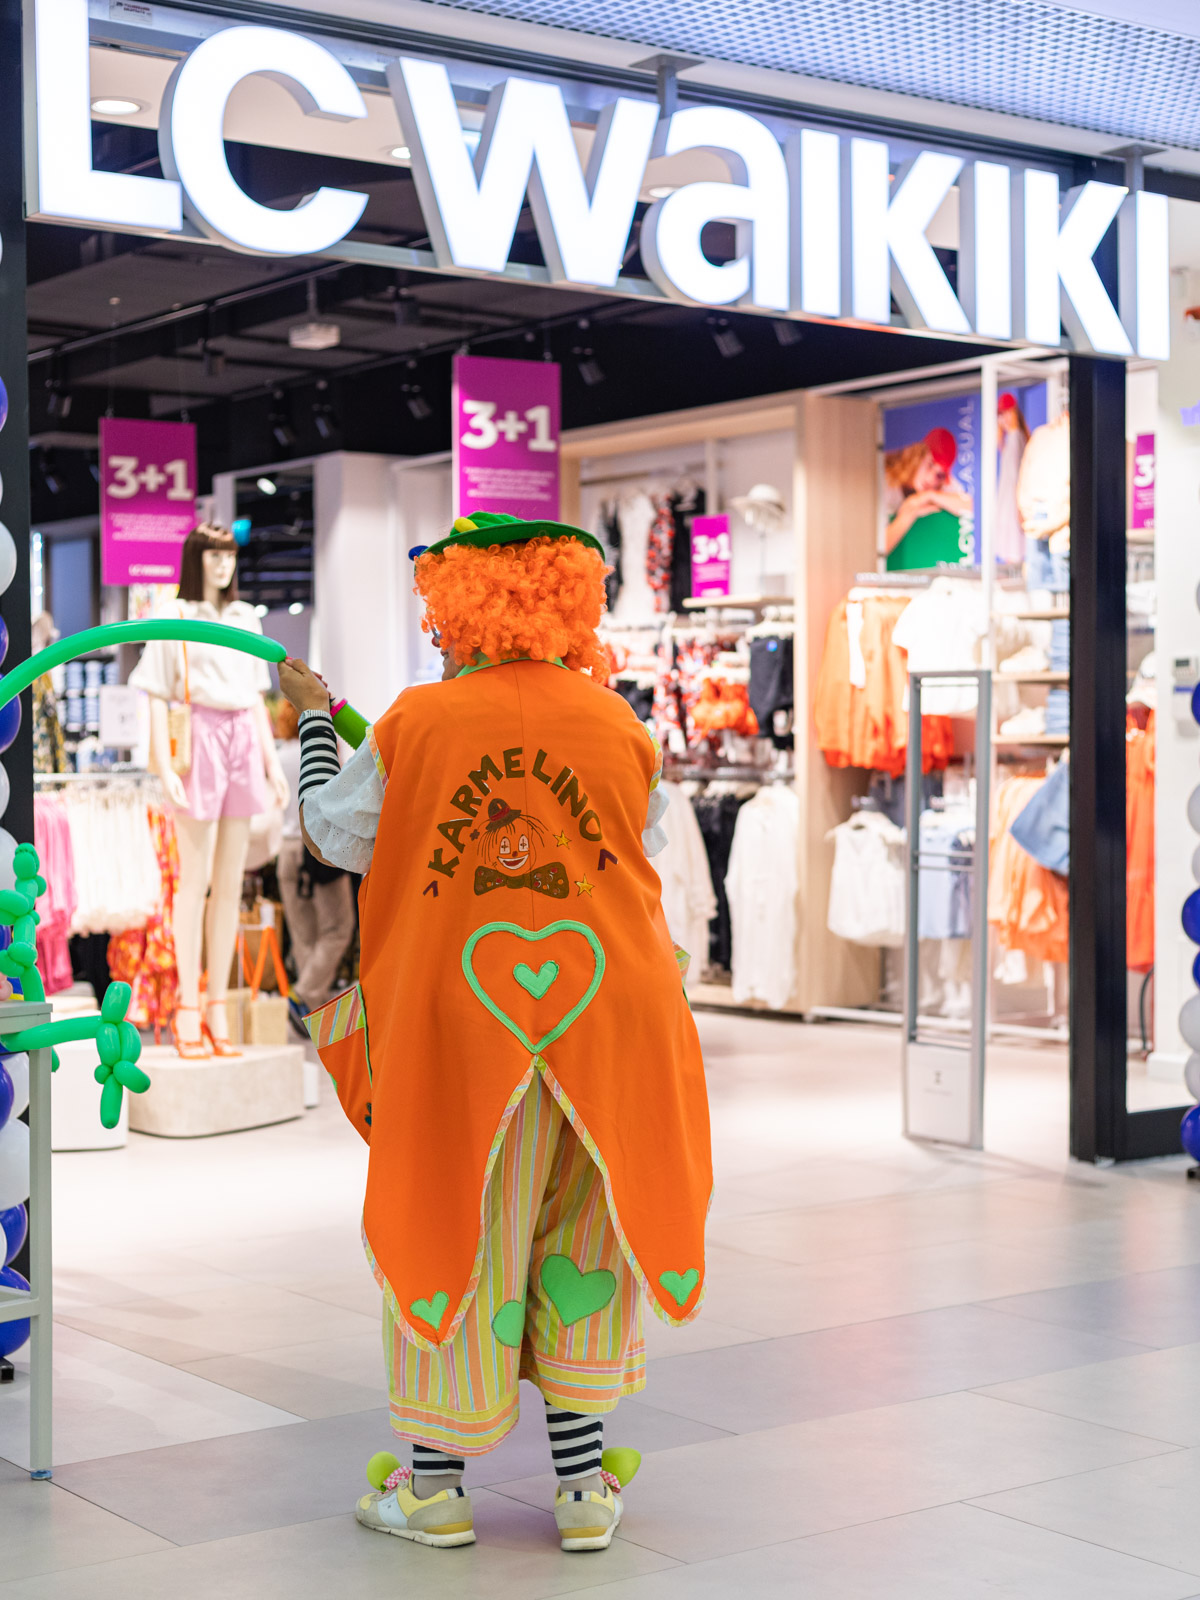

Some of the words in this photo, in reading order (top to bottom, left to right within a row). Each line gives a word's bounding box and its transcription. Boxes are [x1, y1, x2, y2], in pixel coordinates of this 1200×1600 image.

[32, 0, 370, 255] LC
[461, 399, 556, 452] 3+1
[106, 455, 195, 500] 3+1
[428, 747, 603, 878] KARMELINO
